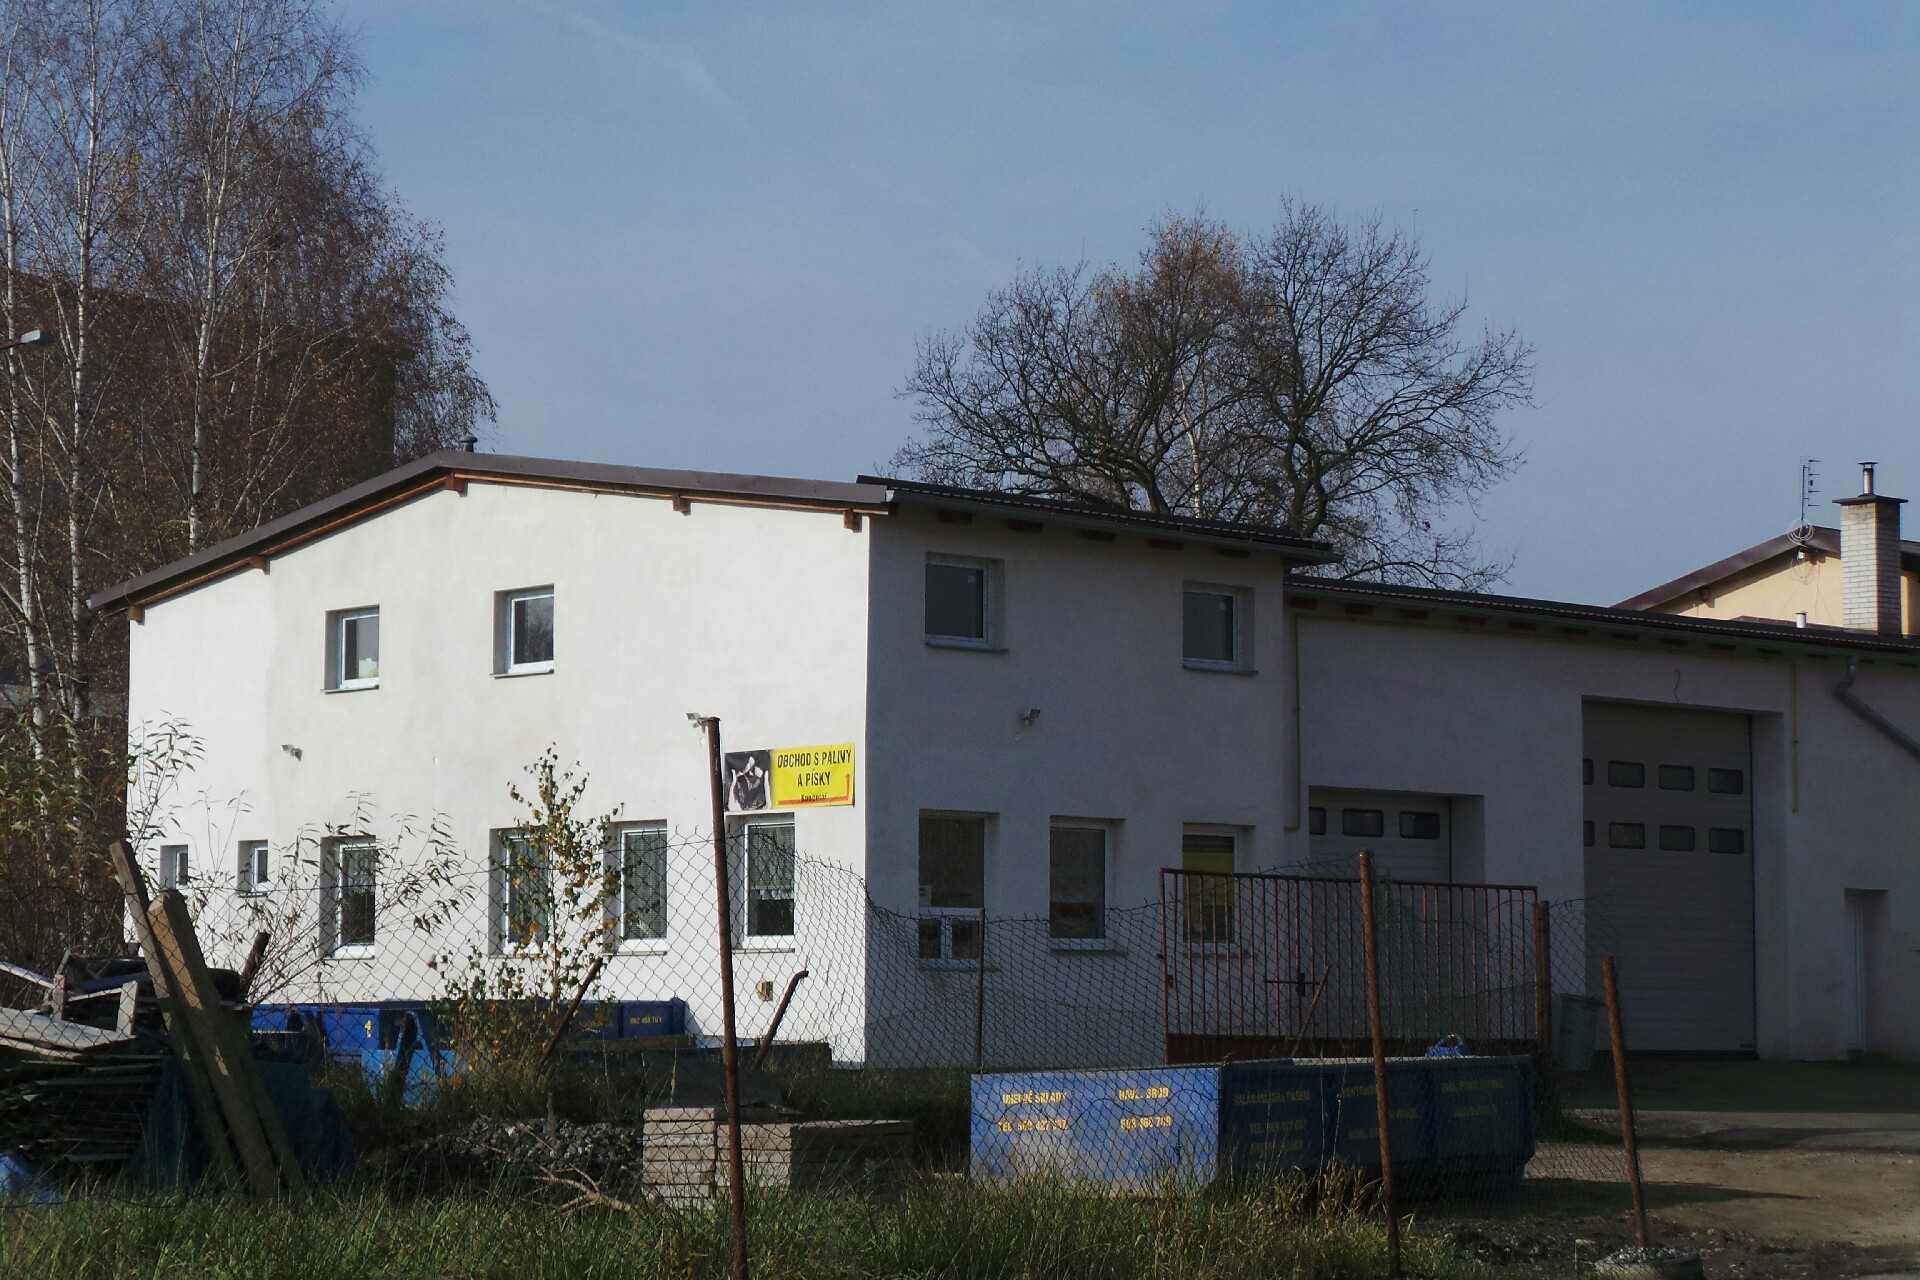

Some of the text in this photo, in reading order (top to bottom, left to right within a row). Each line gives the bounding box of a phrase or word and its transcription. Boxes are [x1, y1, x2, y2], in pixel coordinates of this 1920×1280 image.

[778, 749, 851, 768] OBCHOD S PALIVY
[797, 769, 831, 787] A PÍSKY
